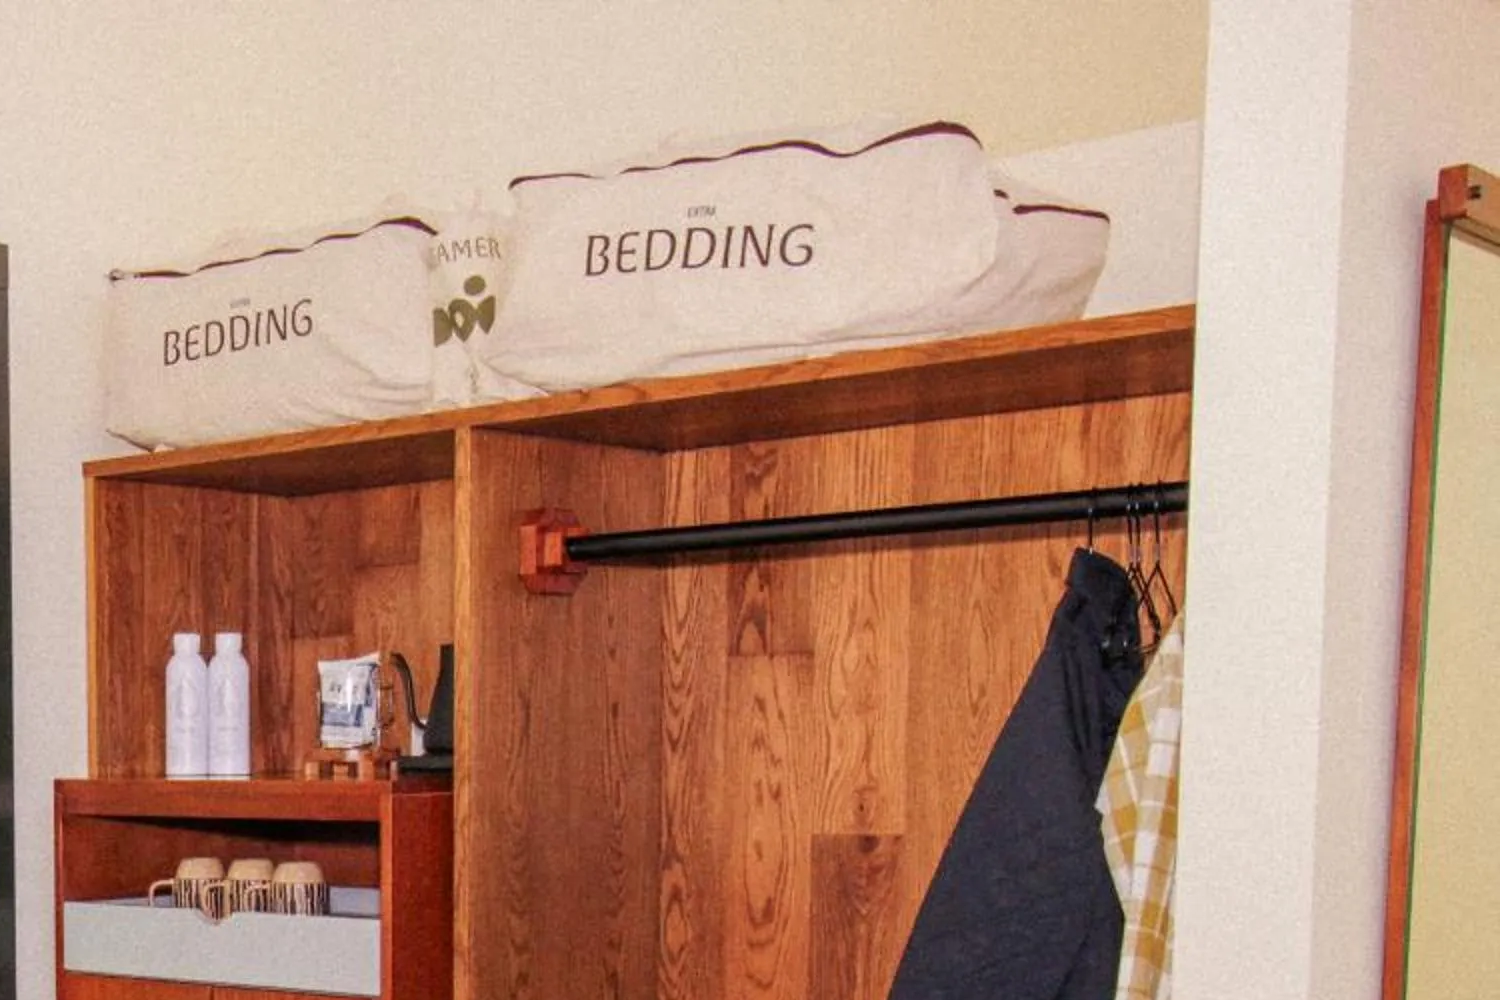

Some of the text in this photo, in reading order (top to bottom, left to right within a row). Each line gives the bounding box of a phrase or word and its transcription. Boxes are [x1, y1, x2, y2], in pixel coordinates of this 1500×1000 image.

[436, 237, 501, 263] AMER
[585, 223, 815, 276] BEDDING
[163, 299, 314, 367] BEDDING
